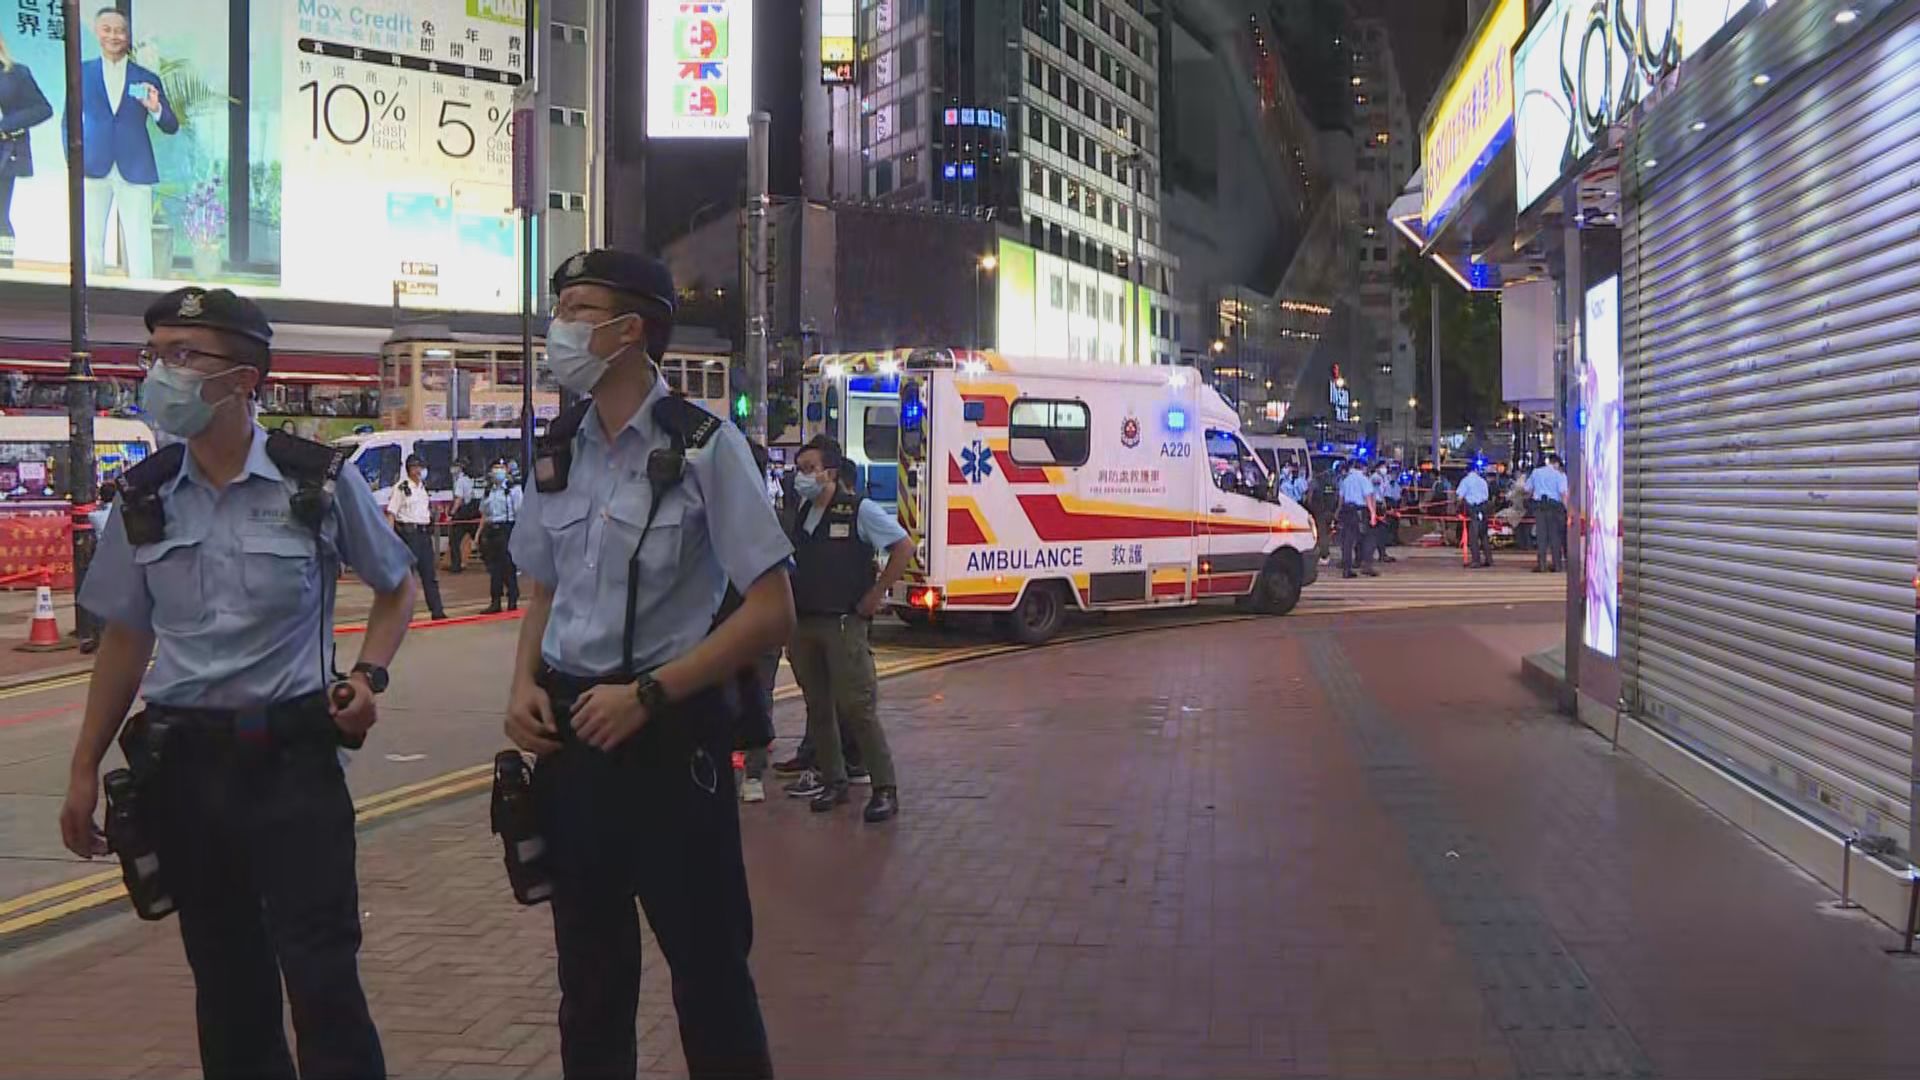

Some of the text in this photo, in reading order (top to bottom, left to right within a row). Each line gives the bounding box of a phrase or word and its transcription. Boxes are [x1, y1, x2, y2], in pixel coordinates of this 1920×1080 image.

[299, 0, 342, 22] Mox
[350, 9, 413, 34] Credit
[299, 80, 406, 145] 10%
[372, 120, 407, 138] Cash
[437, 99, 513, 158] 5%
[372, 135, 407, 151] Back
[486, 137, 512, 152] Cas
[486, 150, 512, 164] Bac
[1160, 442, 1191, 457] A220
[966, 546, 1083, 572] AMBULANCE
[1111, 543, 1143, 566] 救護
